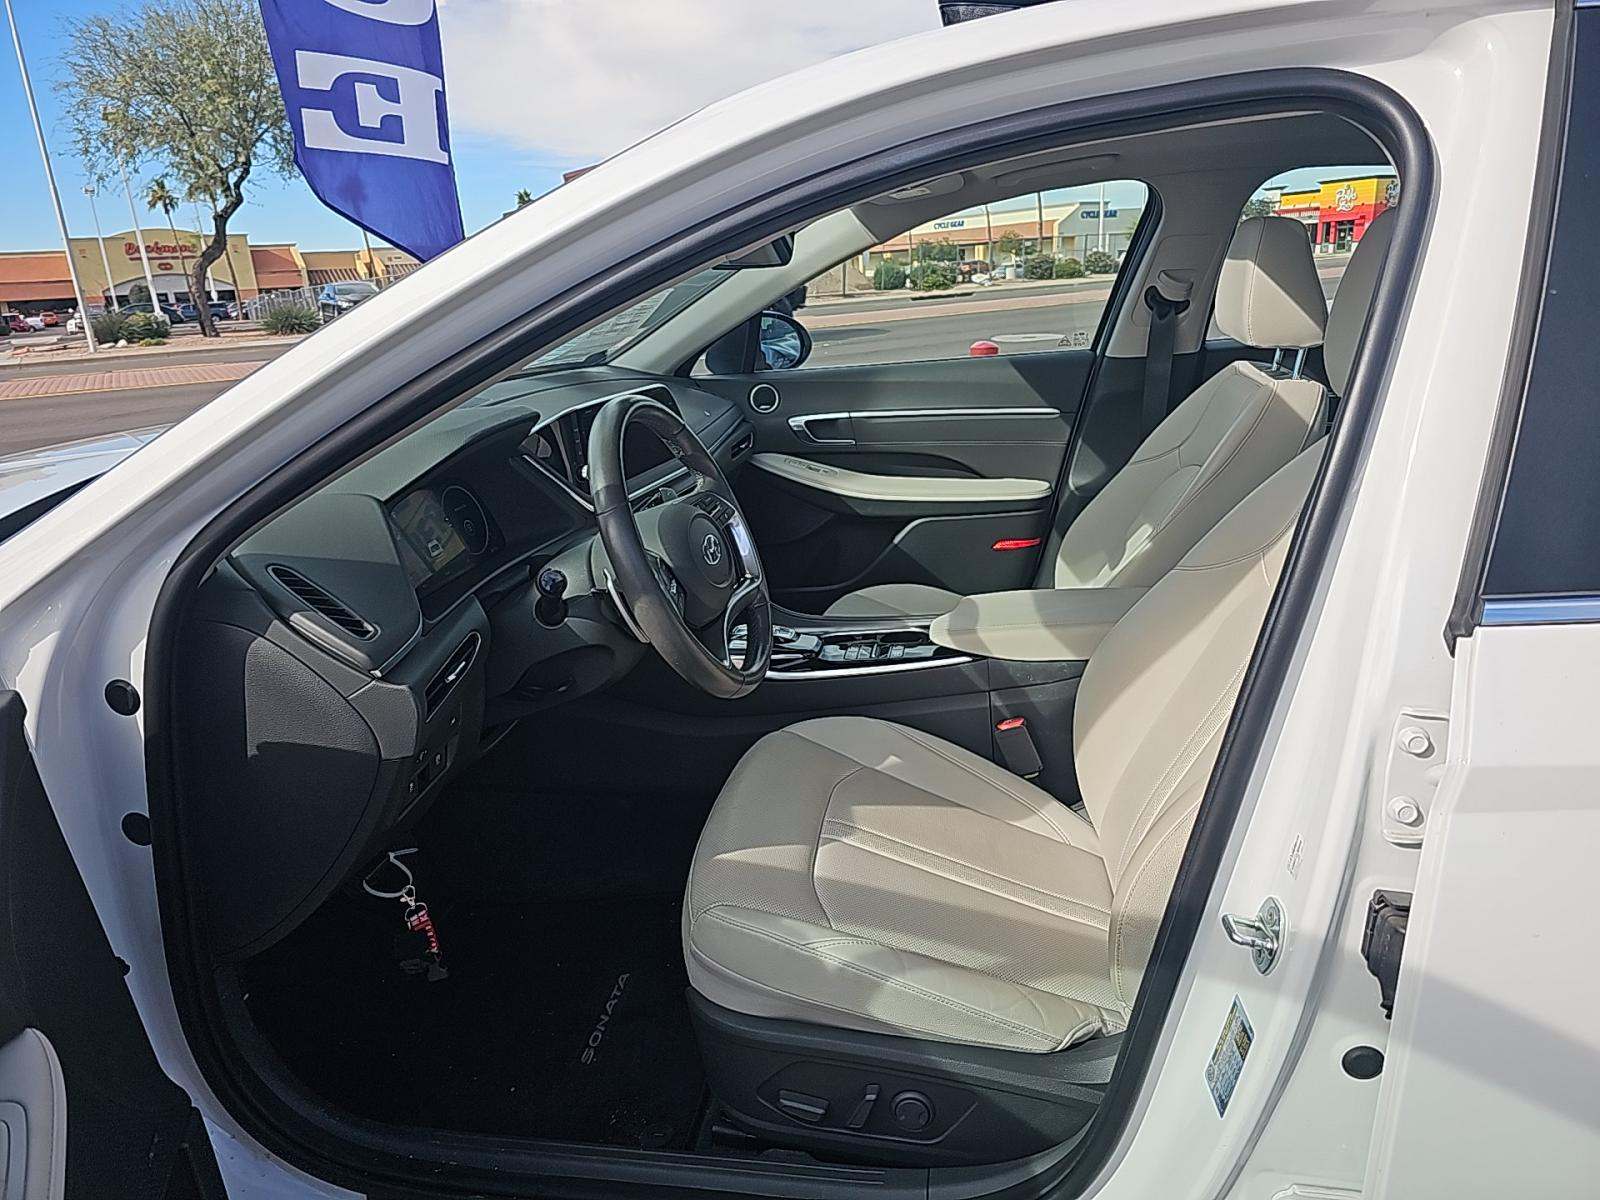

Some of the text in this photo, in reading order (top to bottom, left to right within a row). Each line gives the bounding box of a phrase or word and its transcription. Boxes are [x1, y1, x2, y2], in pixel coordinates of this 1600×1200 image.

[933, 219, 965, 230] CYCLE GEAR
[581, 973, 631, 1064] SONATA
